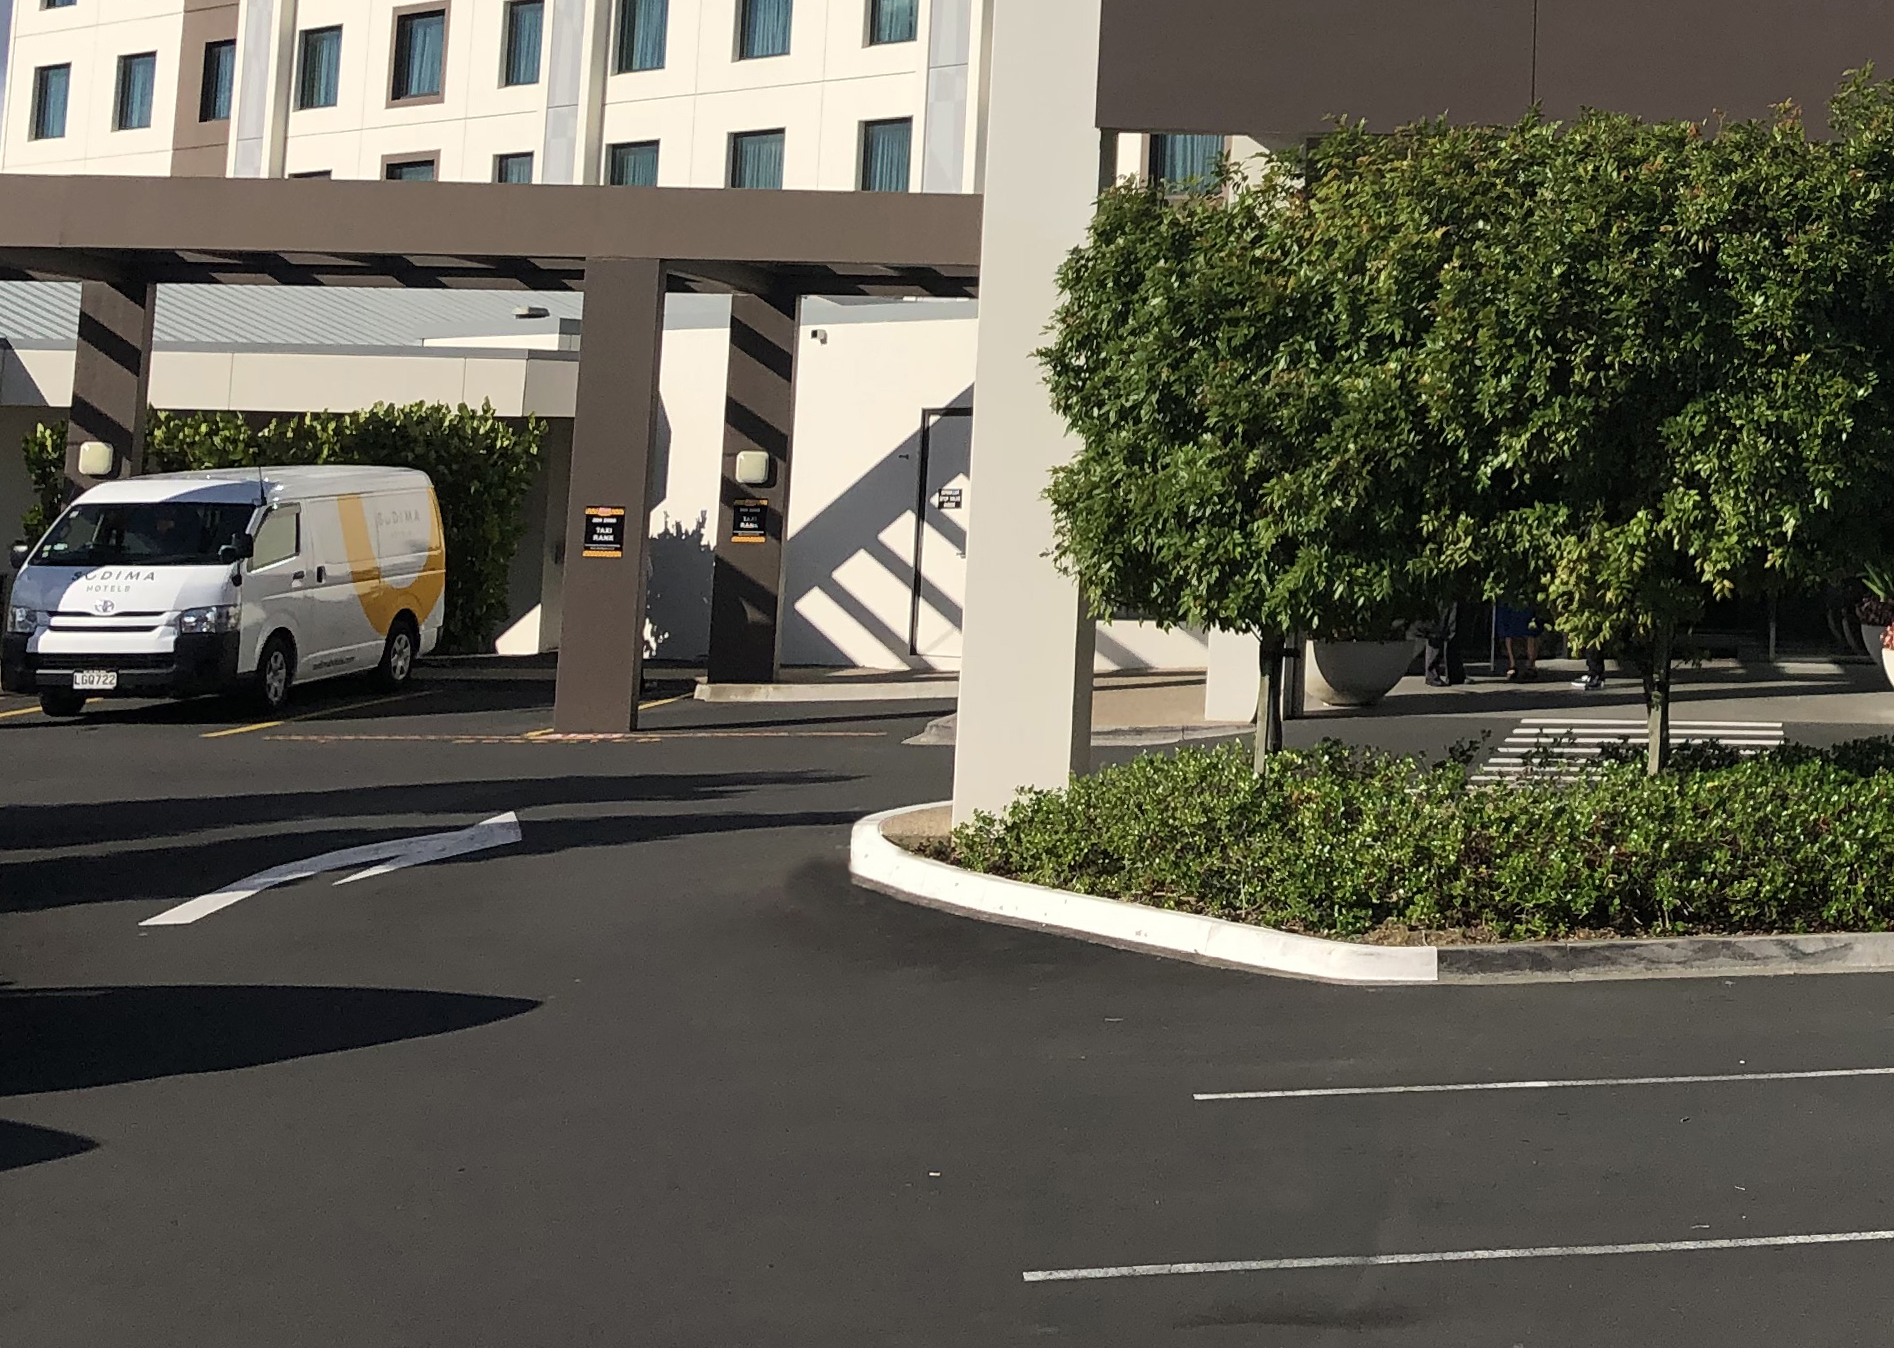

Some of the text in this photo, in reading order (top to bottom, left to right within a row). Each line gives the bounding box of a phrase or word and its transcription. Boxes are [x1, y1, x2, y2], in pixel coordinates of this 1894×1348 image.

[595, 526, 613, 534] TAXI
[592, 534, 615, 542] RANK
[86, 584, 131, 593] HOTELS
